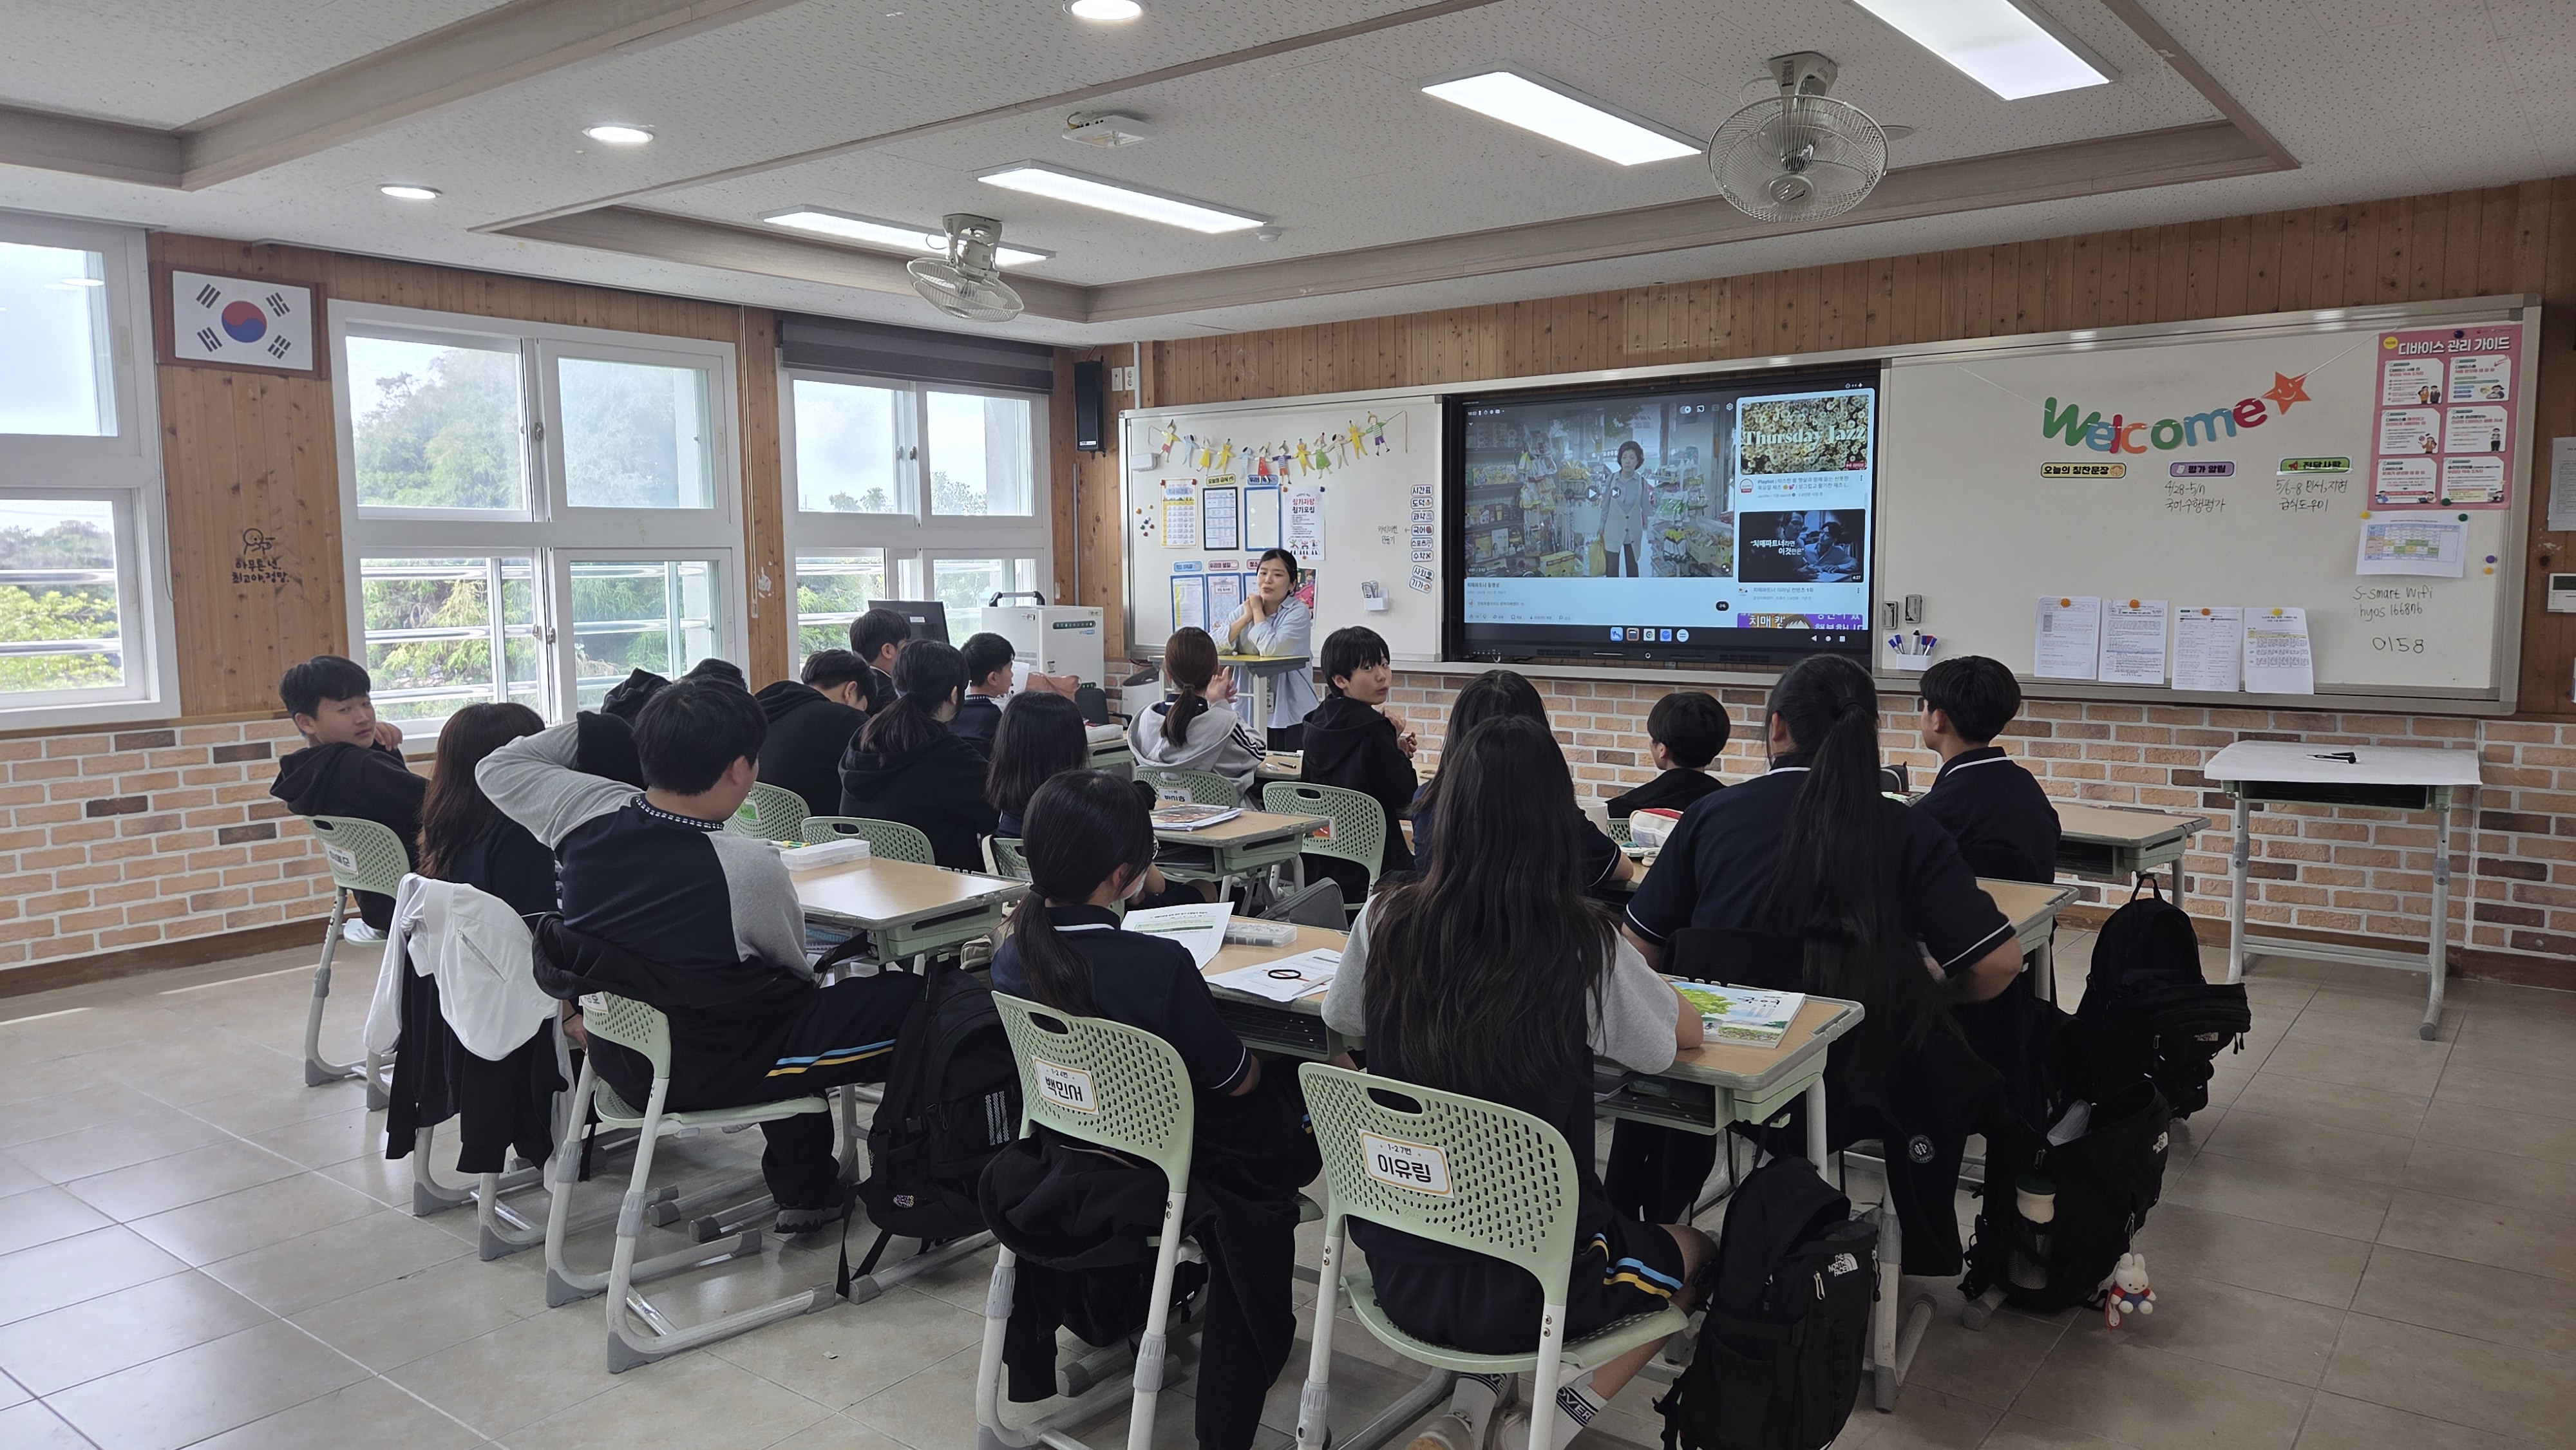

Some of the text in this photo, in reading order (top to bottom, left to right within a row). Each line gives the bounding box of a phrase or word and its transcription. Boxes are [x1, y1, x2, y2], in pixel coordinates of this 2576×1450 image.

[2398, 336, 2510, 355] 디바이스 관리 가이드
[2043, 397, 2268, 454] Welcome
[1743, 425, 1866, 447] Thursday Jazz
[2043, 466, 2110, 475] 오늘의 칭찬문장
[2188, 464, 2226, 474] 평가 알림
[1412, 486, 1432, 494] 시간표
[2276, 479, 2303, 496] 5/6-8
[2278, 496, 2329, 513] 급식도우미
[235, 558, 267, 572] 아무튼
[1414, 567, 1426, 576] 사회
[1411, 578, 1424, 589] 기가
[2353, 585, 2401, 600] S-smart
[1749, 616, 1771, 628] 치매
[2372, 636, 2425, 654] 0158
[1045, 1076, 1083, 1102] 백민서
[1387, 1144, 1412, 1156] 1-2 7번
[1377, 1154, 1432, 1183] 이유림
[1835, 1253, 1845, 1263] THE
[1828, 1260, 1846, 1273] NORTH
[1833, 1265, 1848, 1277] FACE
